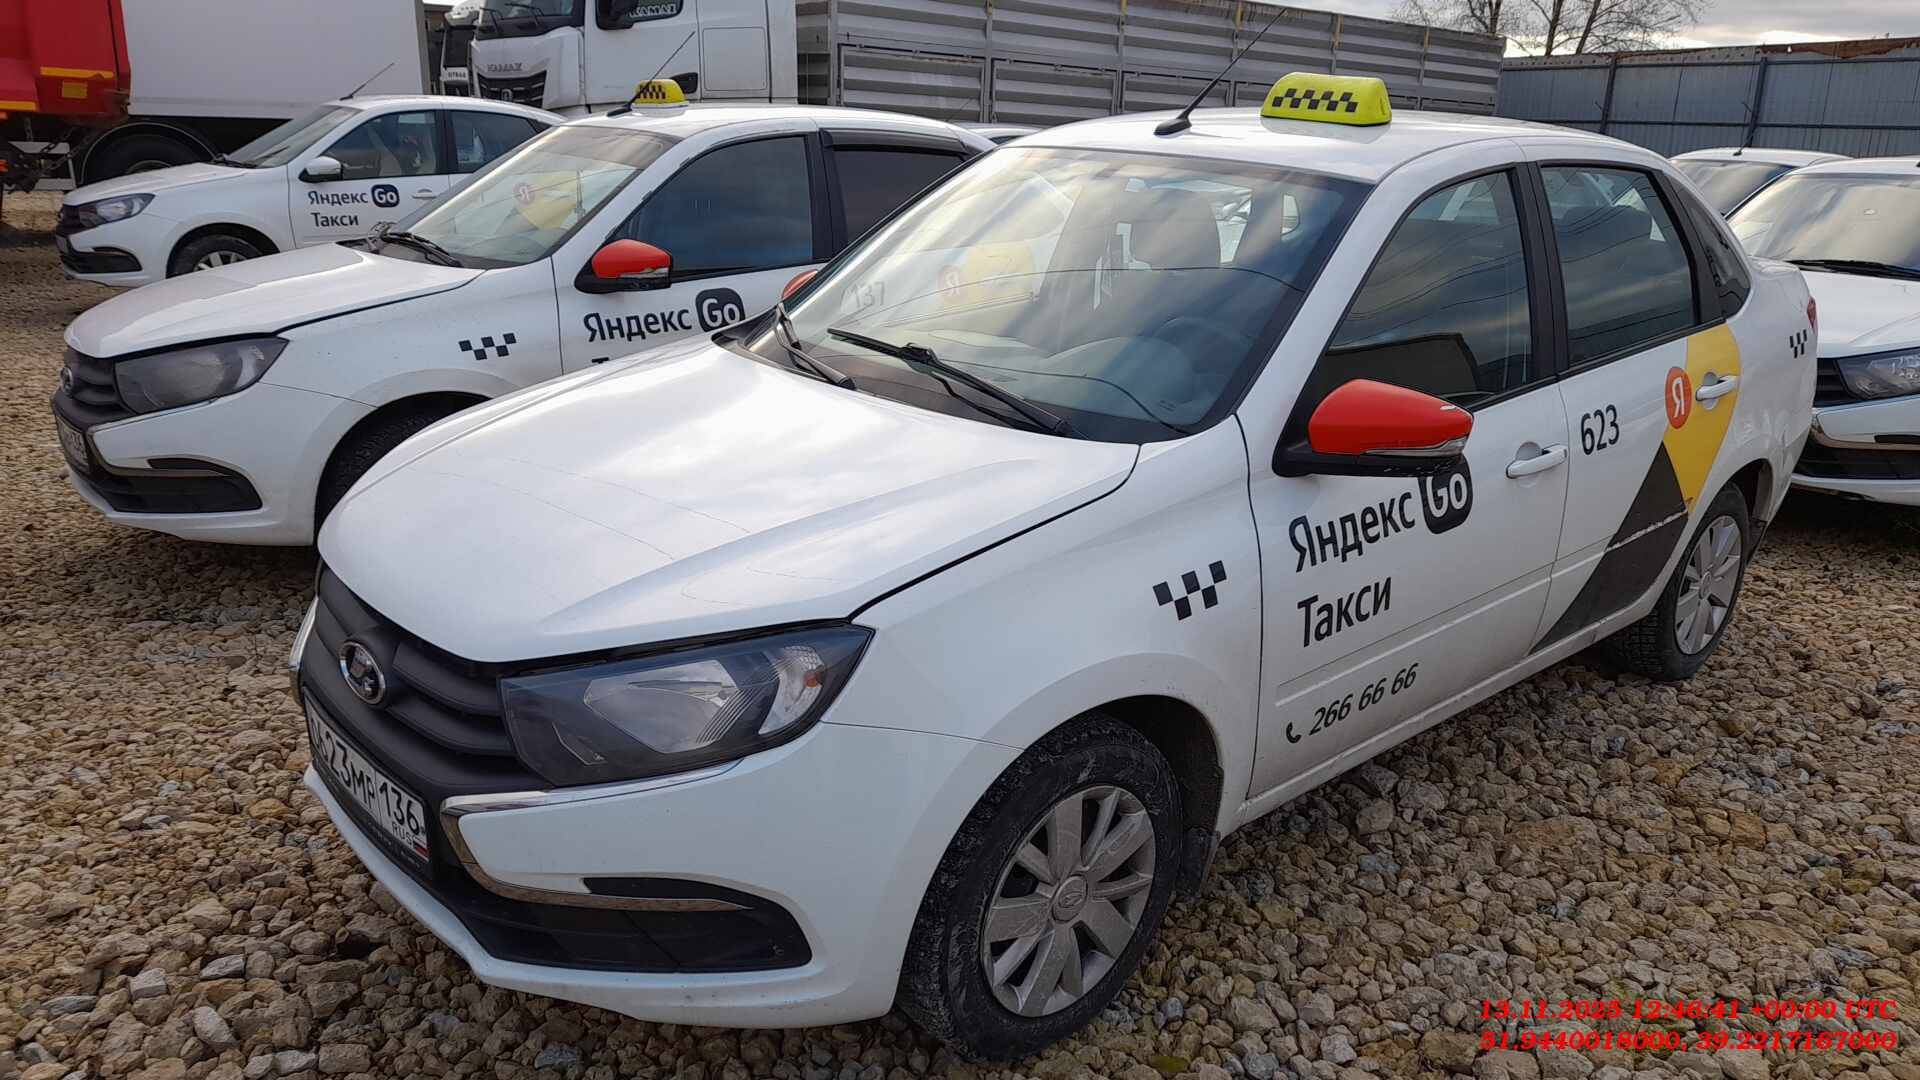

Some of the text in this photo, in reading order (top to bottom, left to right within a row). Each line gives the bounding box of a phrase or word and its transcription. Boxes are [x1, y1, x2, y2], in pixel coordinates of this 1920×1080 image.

[308, 188, 397, 206] Яндекс Go
[311, 212, 359, 227] Такси
[583, 298, 741, 342] Яндекс Go
[1671, 376, 1685, 418] Я
[1580, 404, 1620, 455] 623
[1288, 473, 1468, 573] Яндекс Go
[1297, 577, 1391, 647] Такси
[1308, 663, 1419, 736] 266 66 66
[379, 782, 420, 836] 136
[391, 823, 415, 848] RUS
